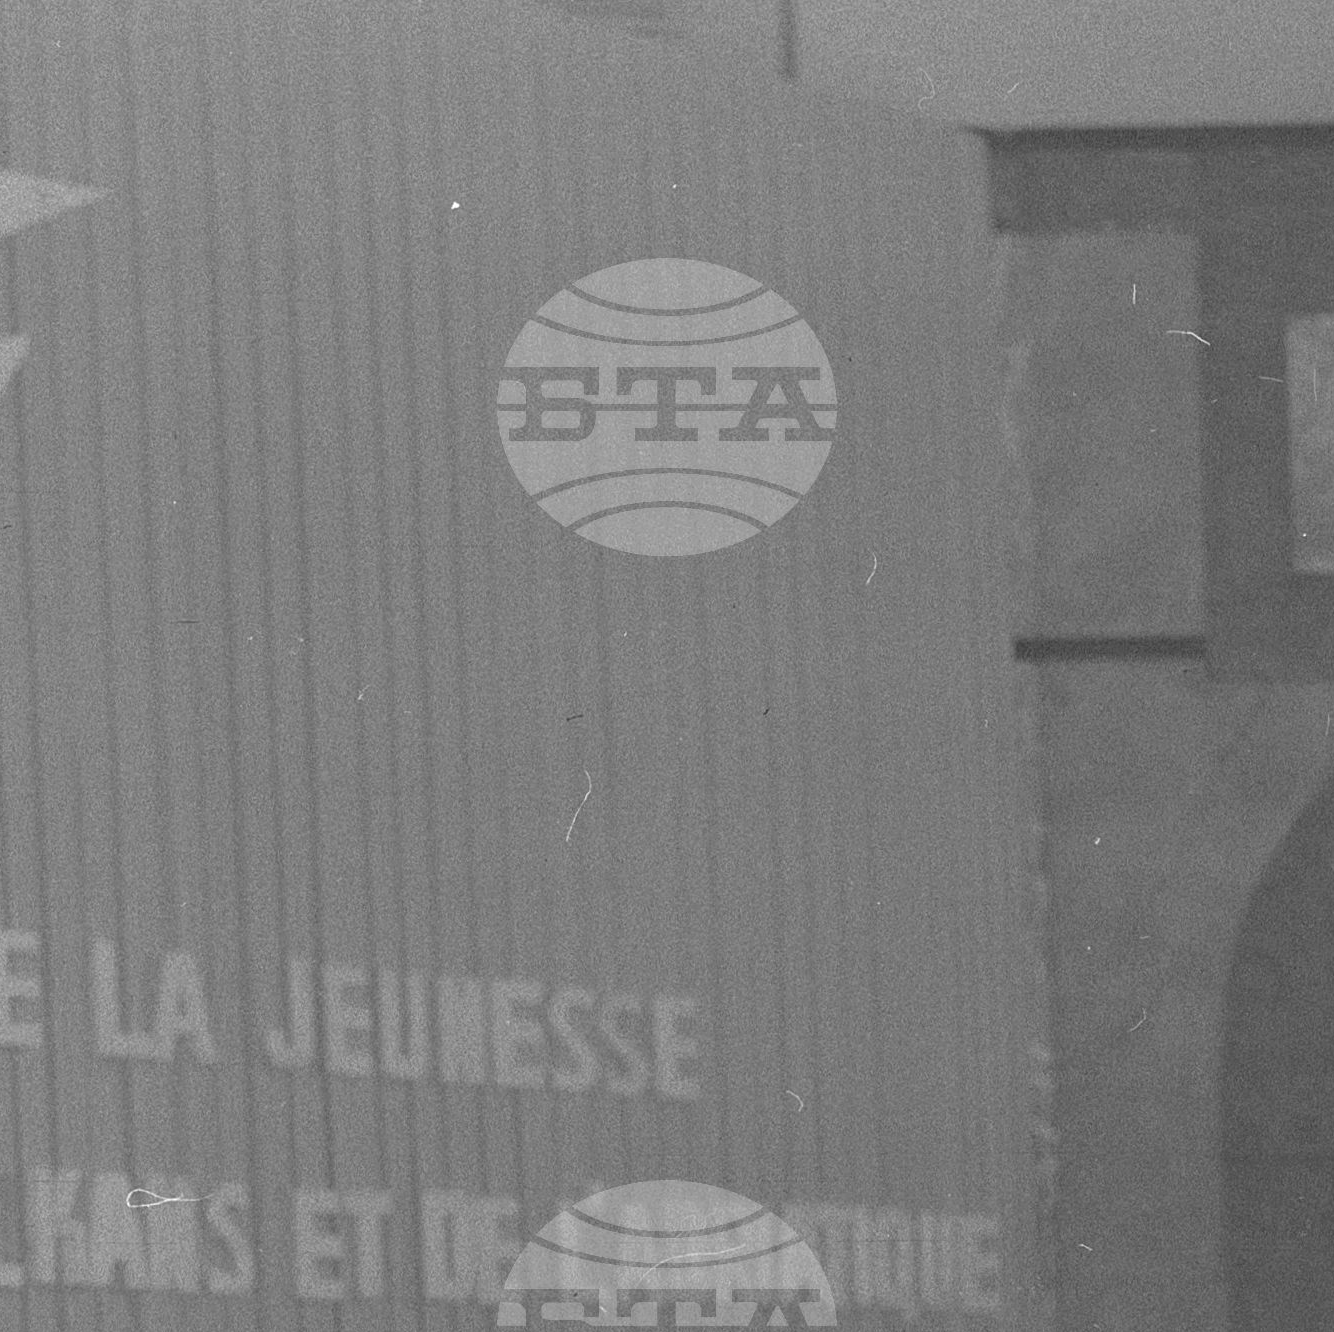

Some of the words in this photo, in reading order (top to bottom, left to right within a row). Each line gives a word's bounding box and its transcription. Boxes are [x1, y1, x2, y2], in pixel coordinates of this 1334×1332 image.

[93, 938, 218, 1066] LA
[263, 952, 703, 1104] JEUNESSE
[294, 1184, 395, 1301] ET
